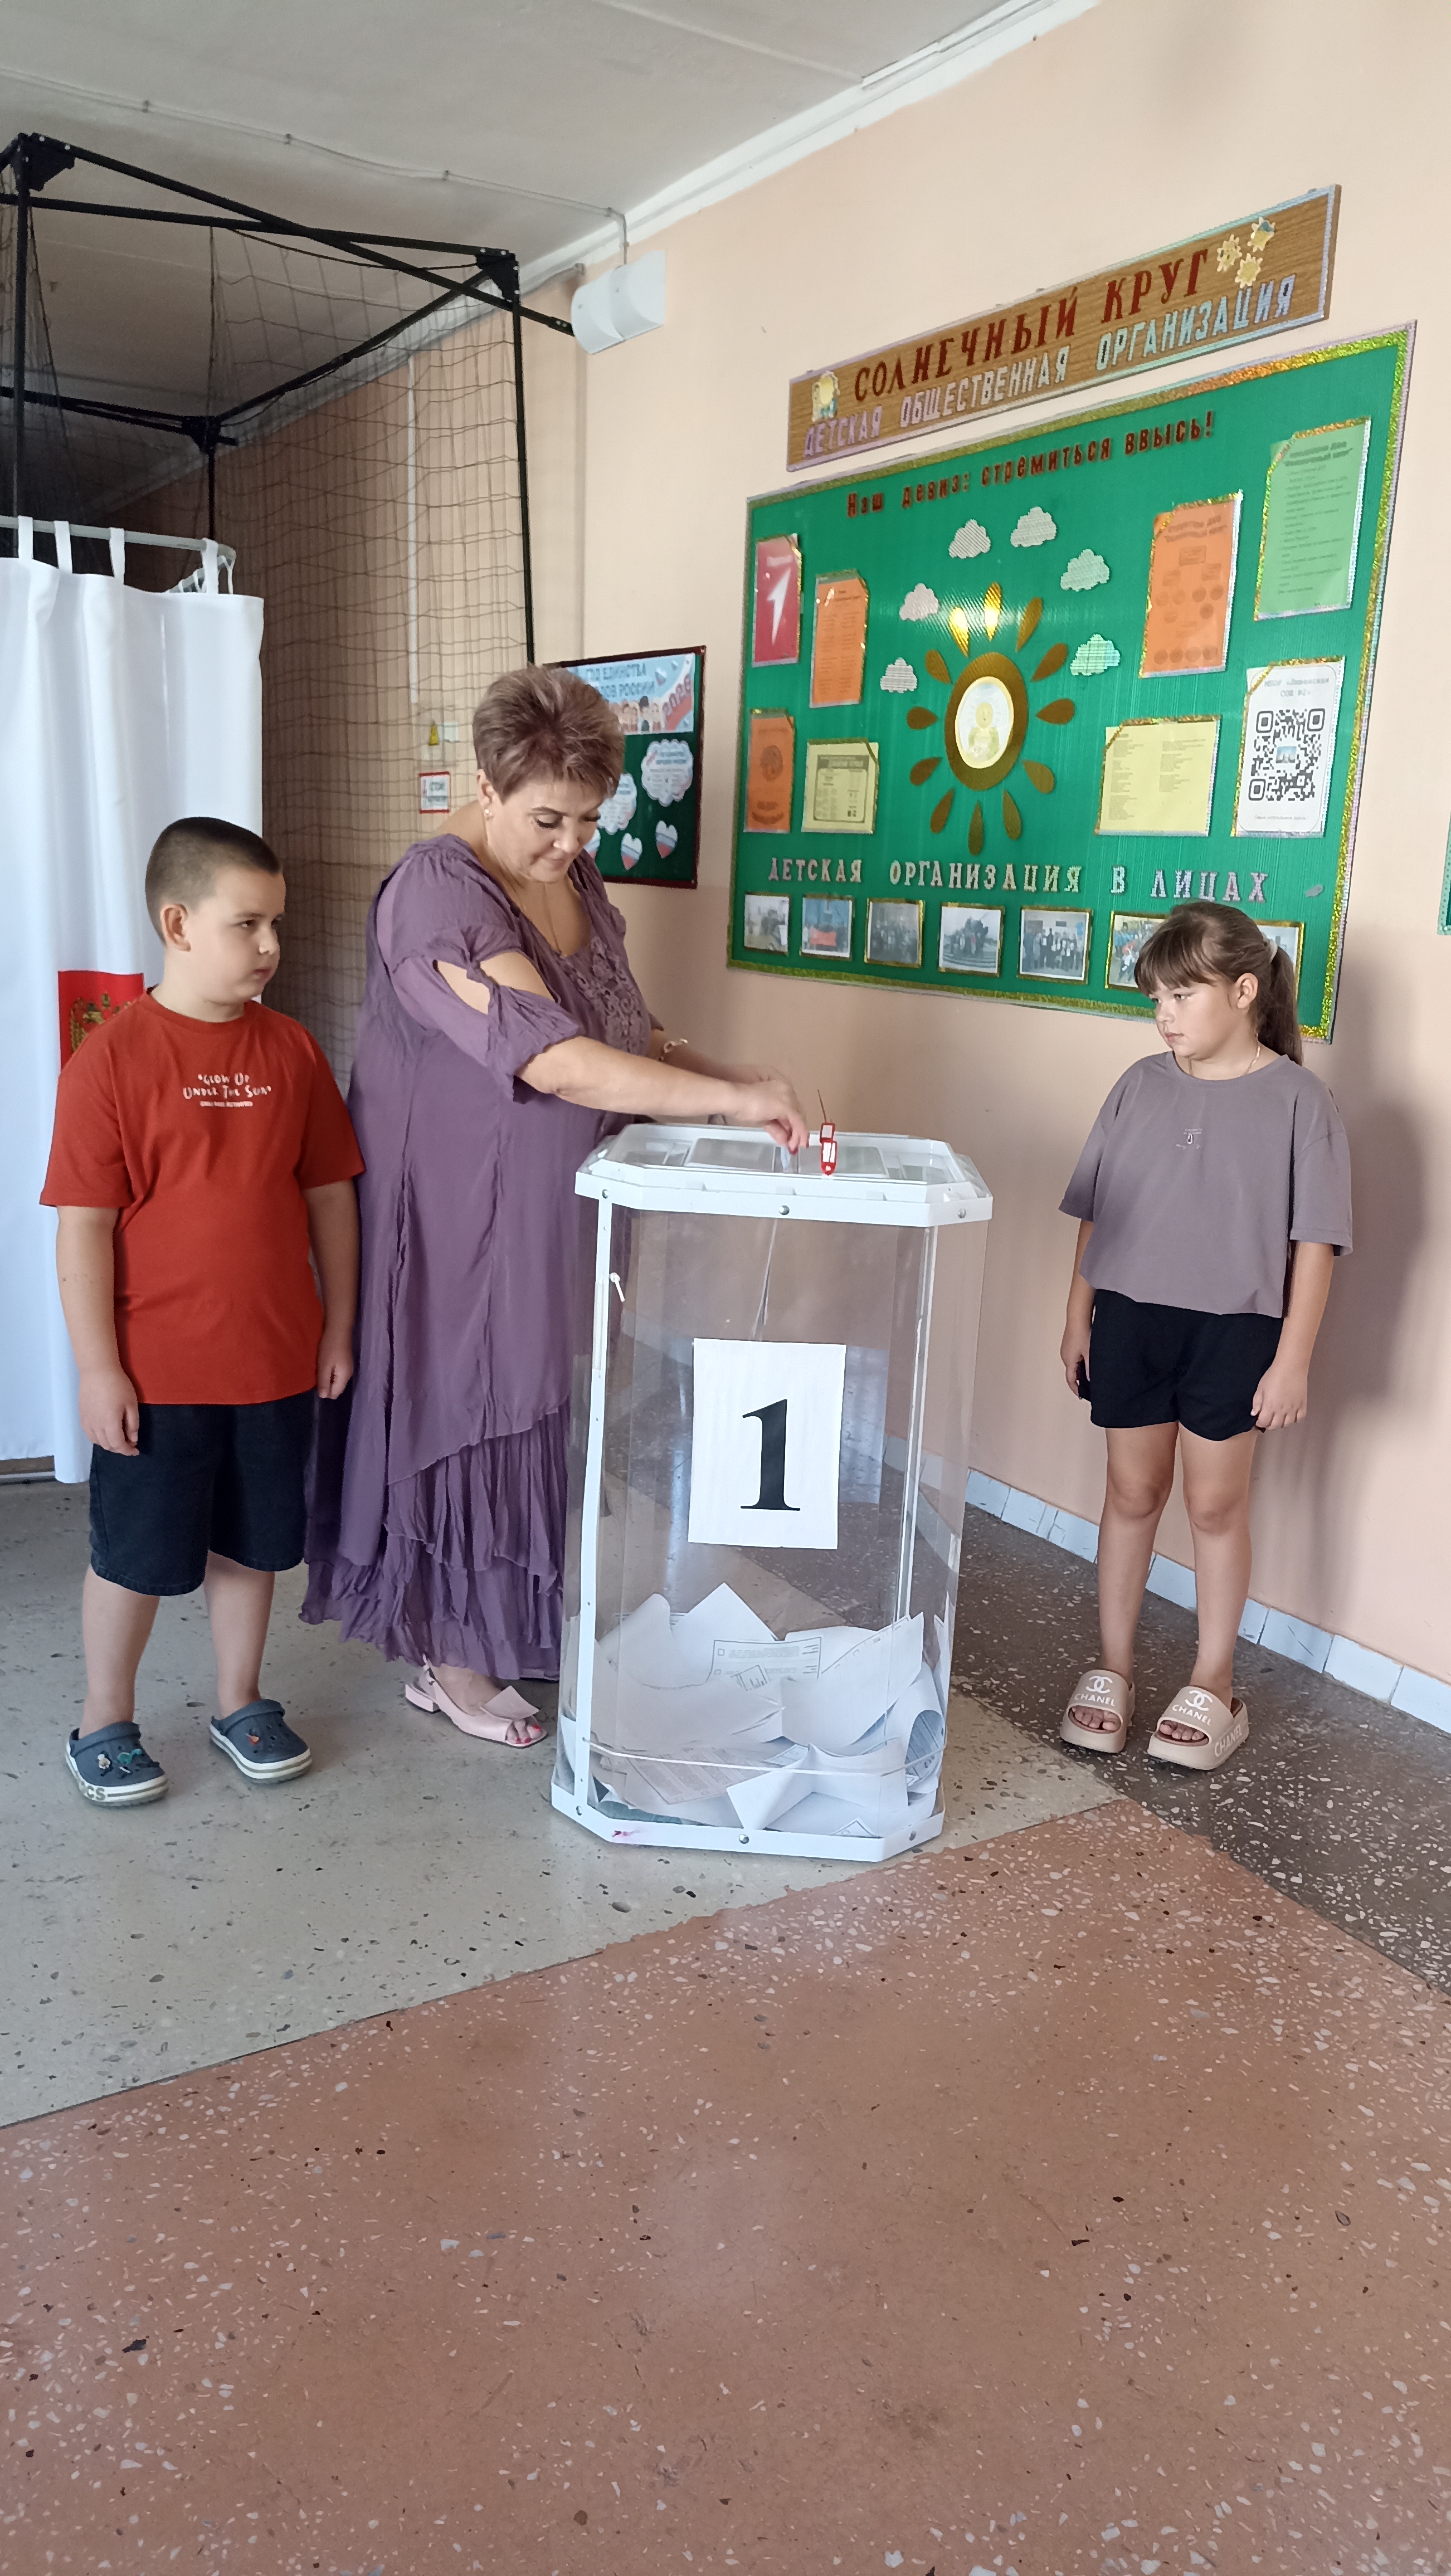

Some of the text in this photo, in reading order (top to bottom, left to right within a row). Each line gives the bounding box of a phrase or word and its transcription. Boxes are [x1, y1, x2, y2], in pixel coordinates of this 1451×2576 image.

[854, 249, 1208, 401] СОЛНЕЧНЫЙ КРУГ
[803, 274, 1297, 457] ДЕТСКАЯ ОБЩЕСТВЕННАЯ ОРГАНИЗАЦИЯ
[847, 492, 884, 518] Наш
[768, 857, 1268, 902] ДЕТСКАЯ ОРГАНИЗАЦИЯ В ЛИЦАХ
[741, 1399, 800, 1511] 1
[1074, 1694, 1116, 1706] CHANEL
[1172, 1704, 1211, 1726] CHANEL
[1214, 1724, 1243, 1757] CHANEL
